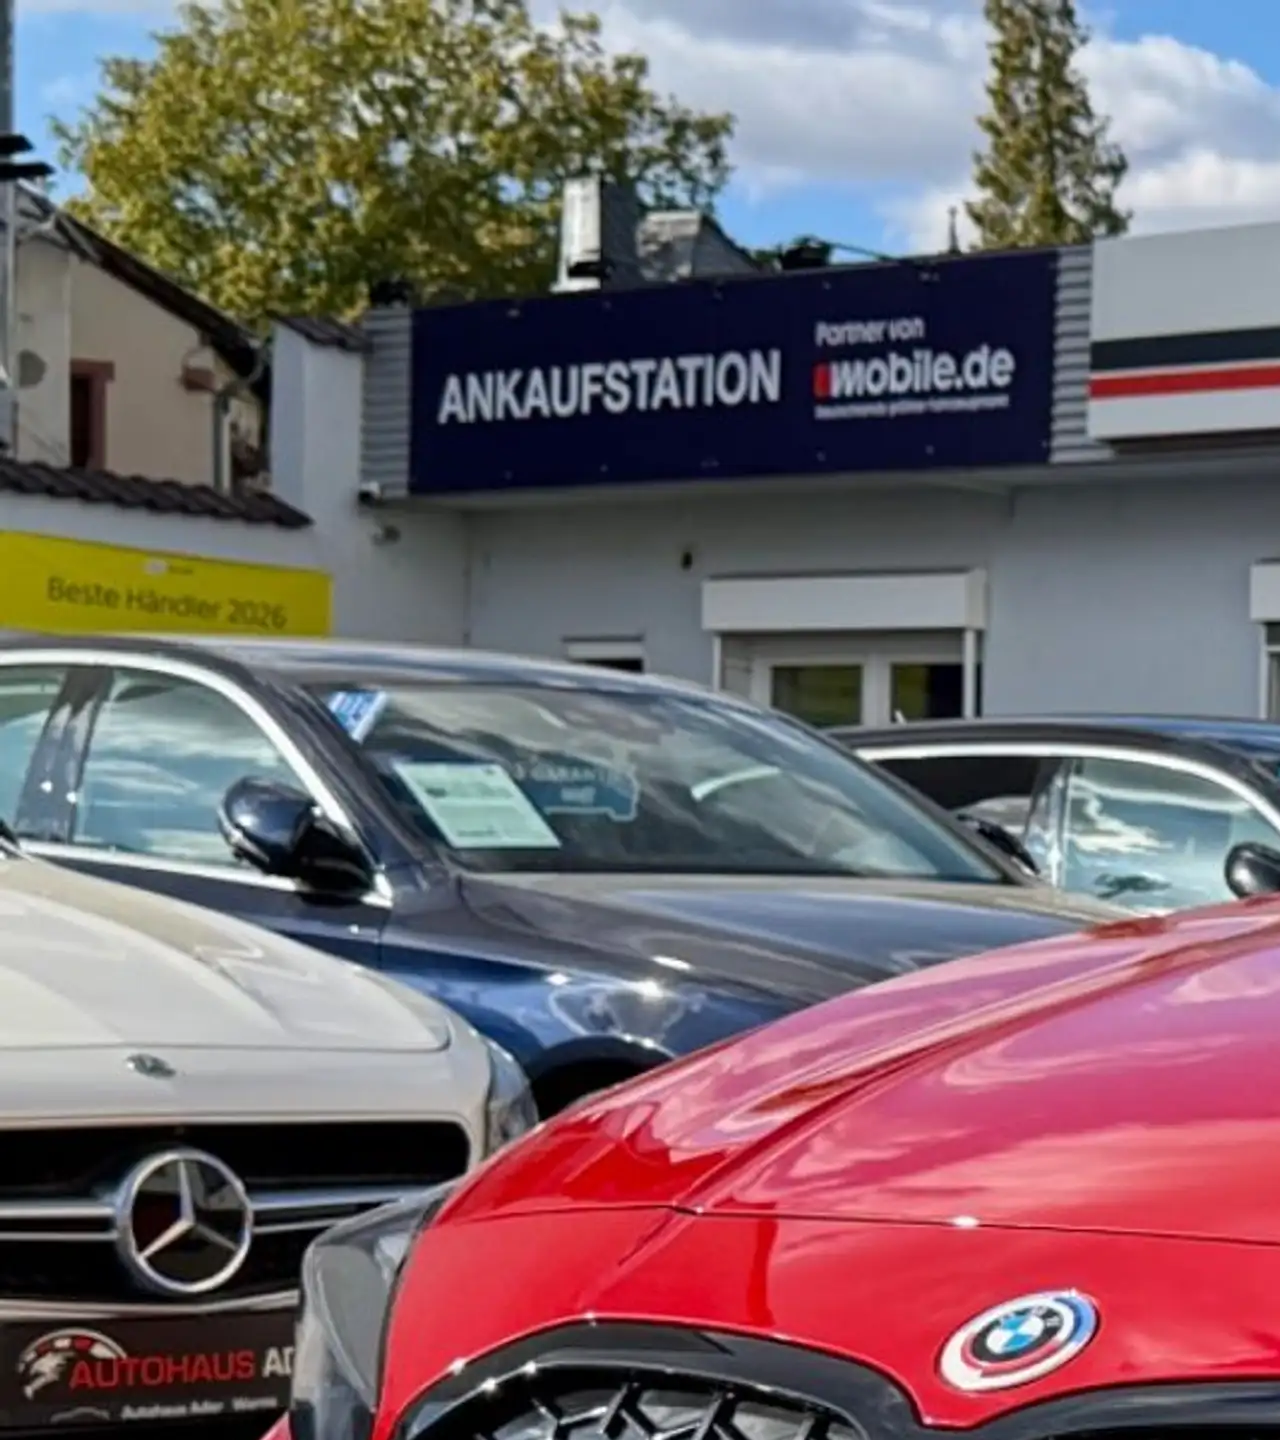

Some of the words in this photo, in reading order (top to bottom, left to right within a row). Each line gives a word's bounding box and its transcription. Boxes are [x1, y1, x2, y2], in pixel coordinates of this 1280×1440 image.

[815, 320, 887, 347] Partner
[889, 317, 925, 341] von
[437, 348, 782, 425] ANKAUFSTATION
[829, 344, 1017, 398] mobile.de
[48, 576, 120, 610] Beste
[126, 588, 221, 622] Händler
[228, 597, 288, 630] 2026
[68, 1350, 256, 1390] AUTOHAUS
